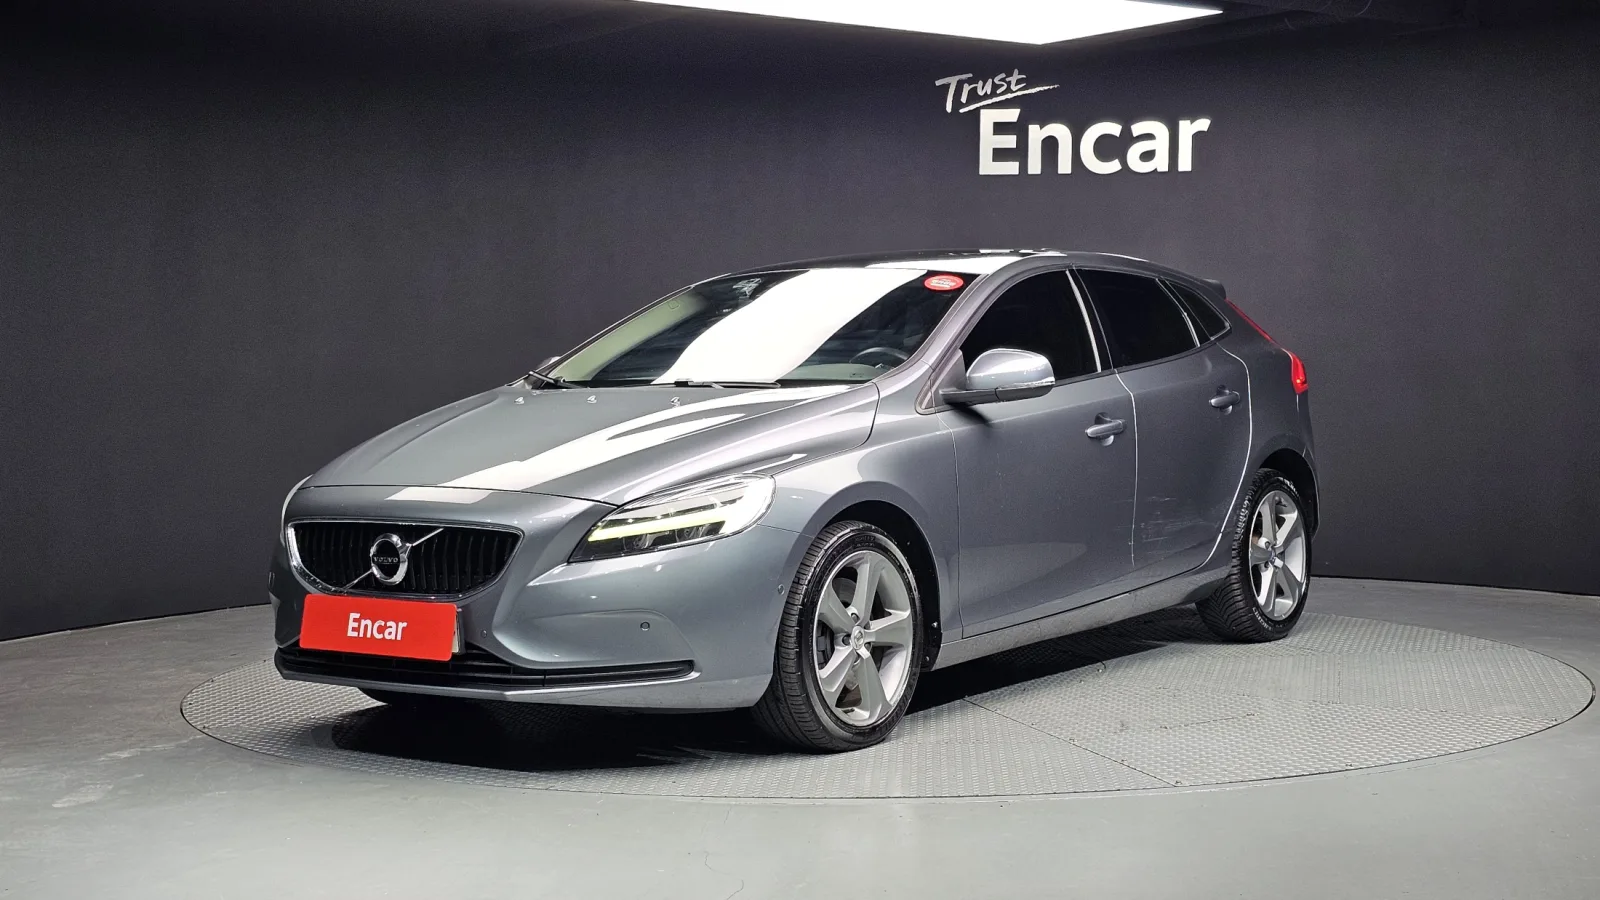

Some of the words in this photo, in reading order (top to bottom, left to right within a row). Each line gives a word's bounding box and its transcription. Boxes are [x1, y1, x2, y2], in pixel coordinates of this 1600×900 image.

[935, 69, 1027, 113] Trust
[979, 108, 1212, 175] Encar
[347, 612, 408, 640] Encar
